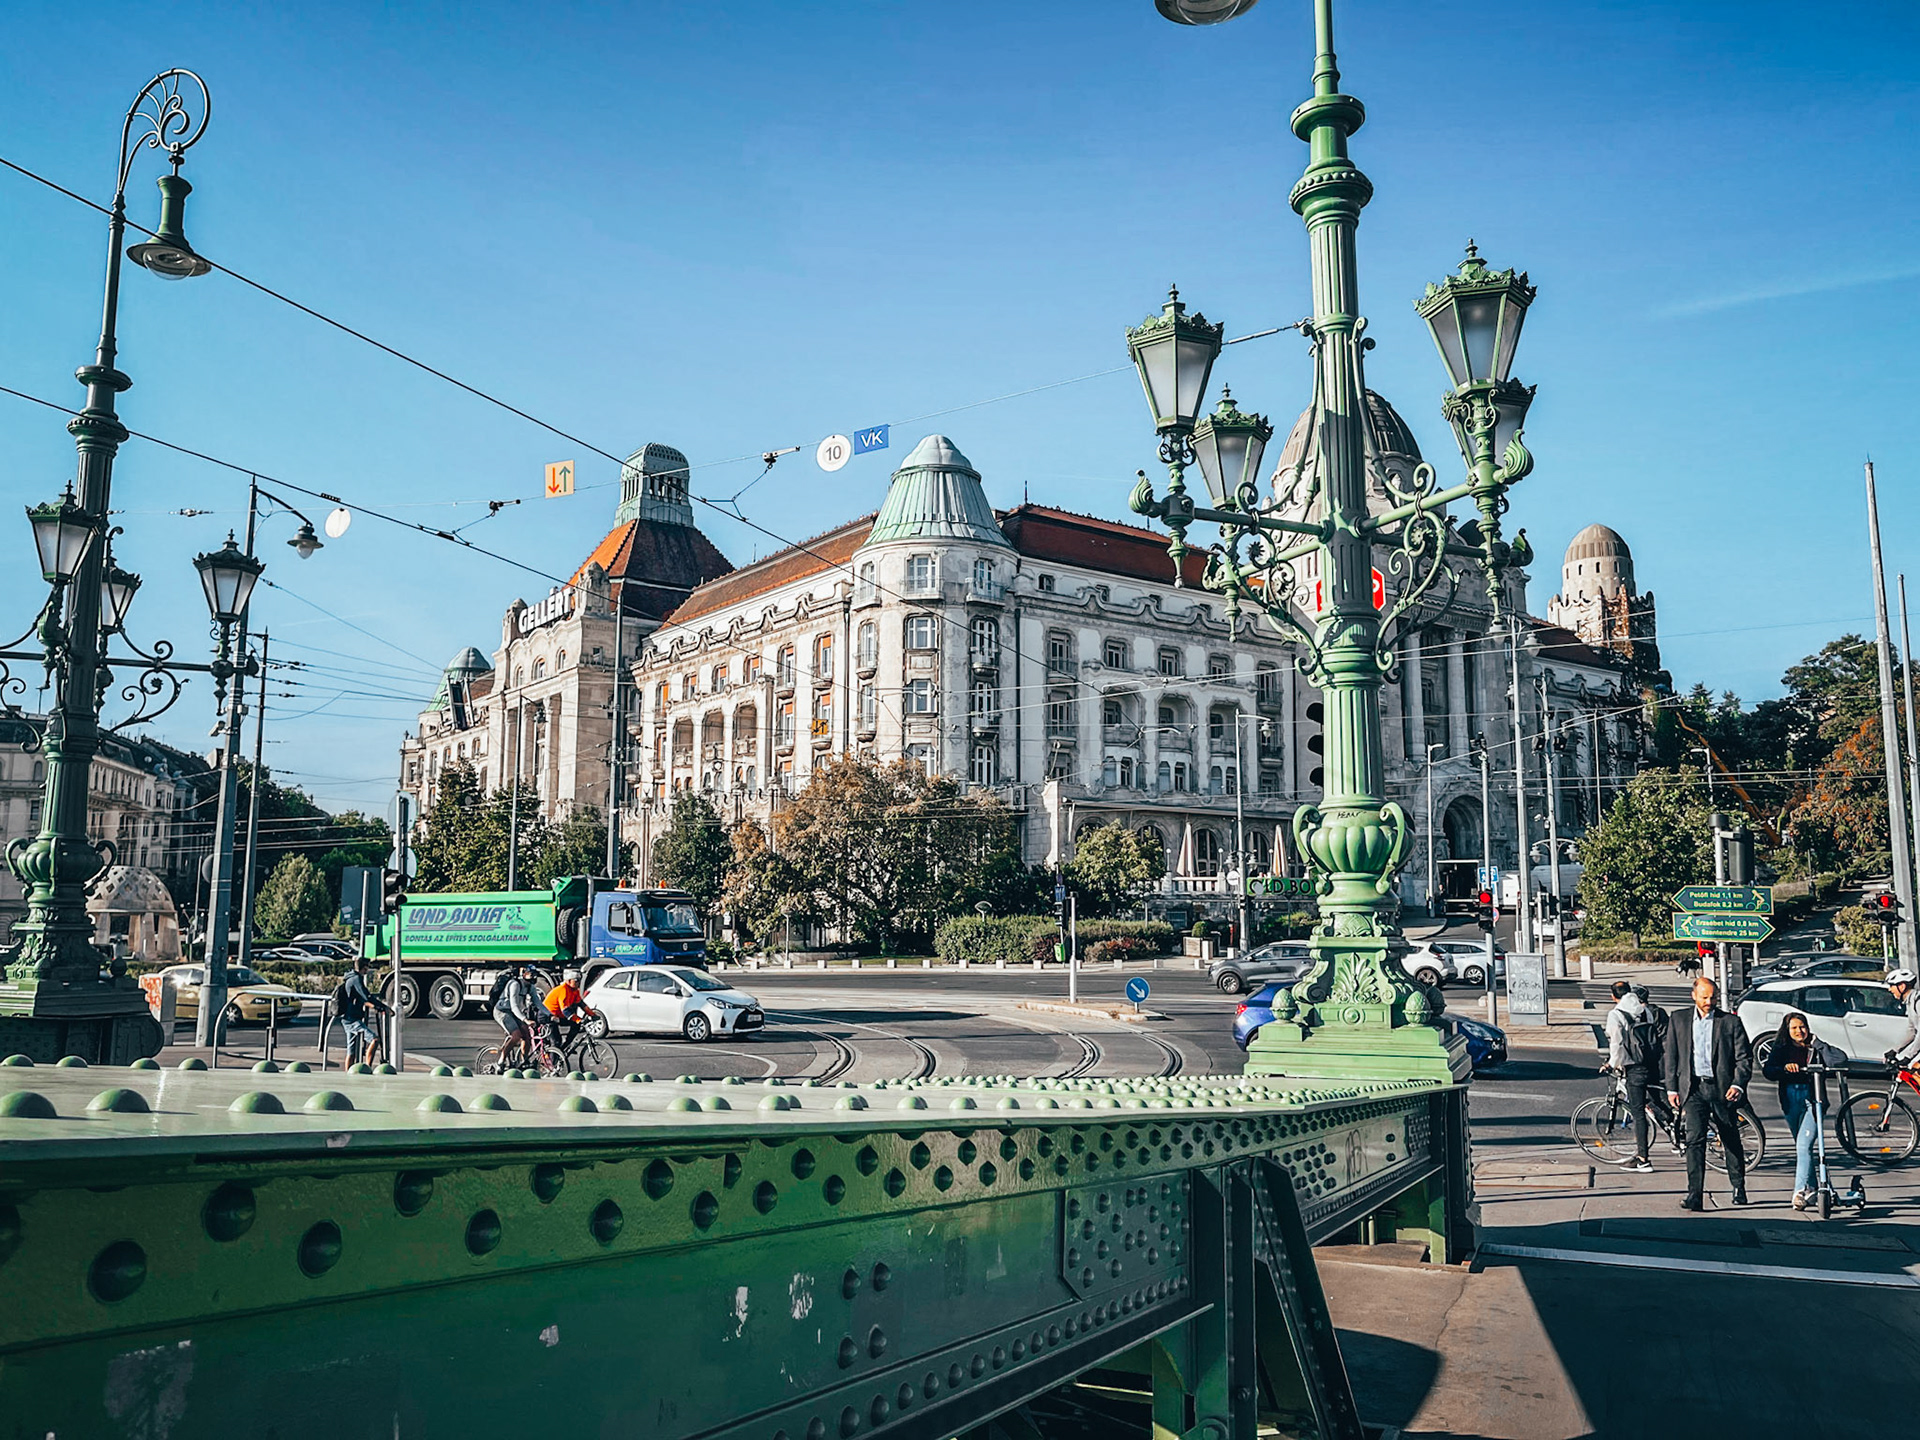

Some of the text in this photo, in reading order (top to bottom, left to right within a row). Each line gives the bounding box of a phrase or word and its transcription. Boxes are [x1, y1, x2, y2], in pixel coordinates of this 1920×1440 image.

[860, 430, 884, 448] VK
[825, 445, 842, 461] 10
[518, 587, 574, 634] GELLÉRT
[478, 907, 507, 923] KFT
[1701, 928, 1737, 936] Szentendre
